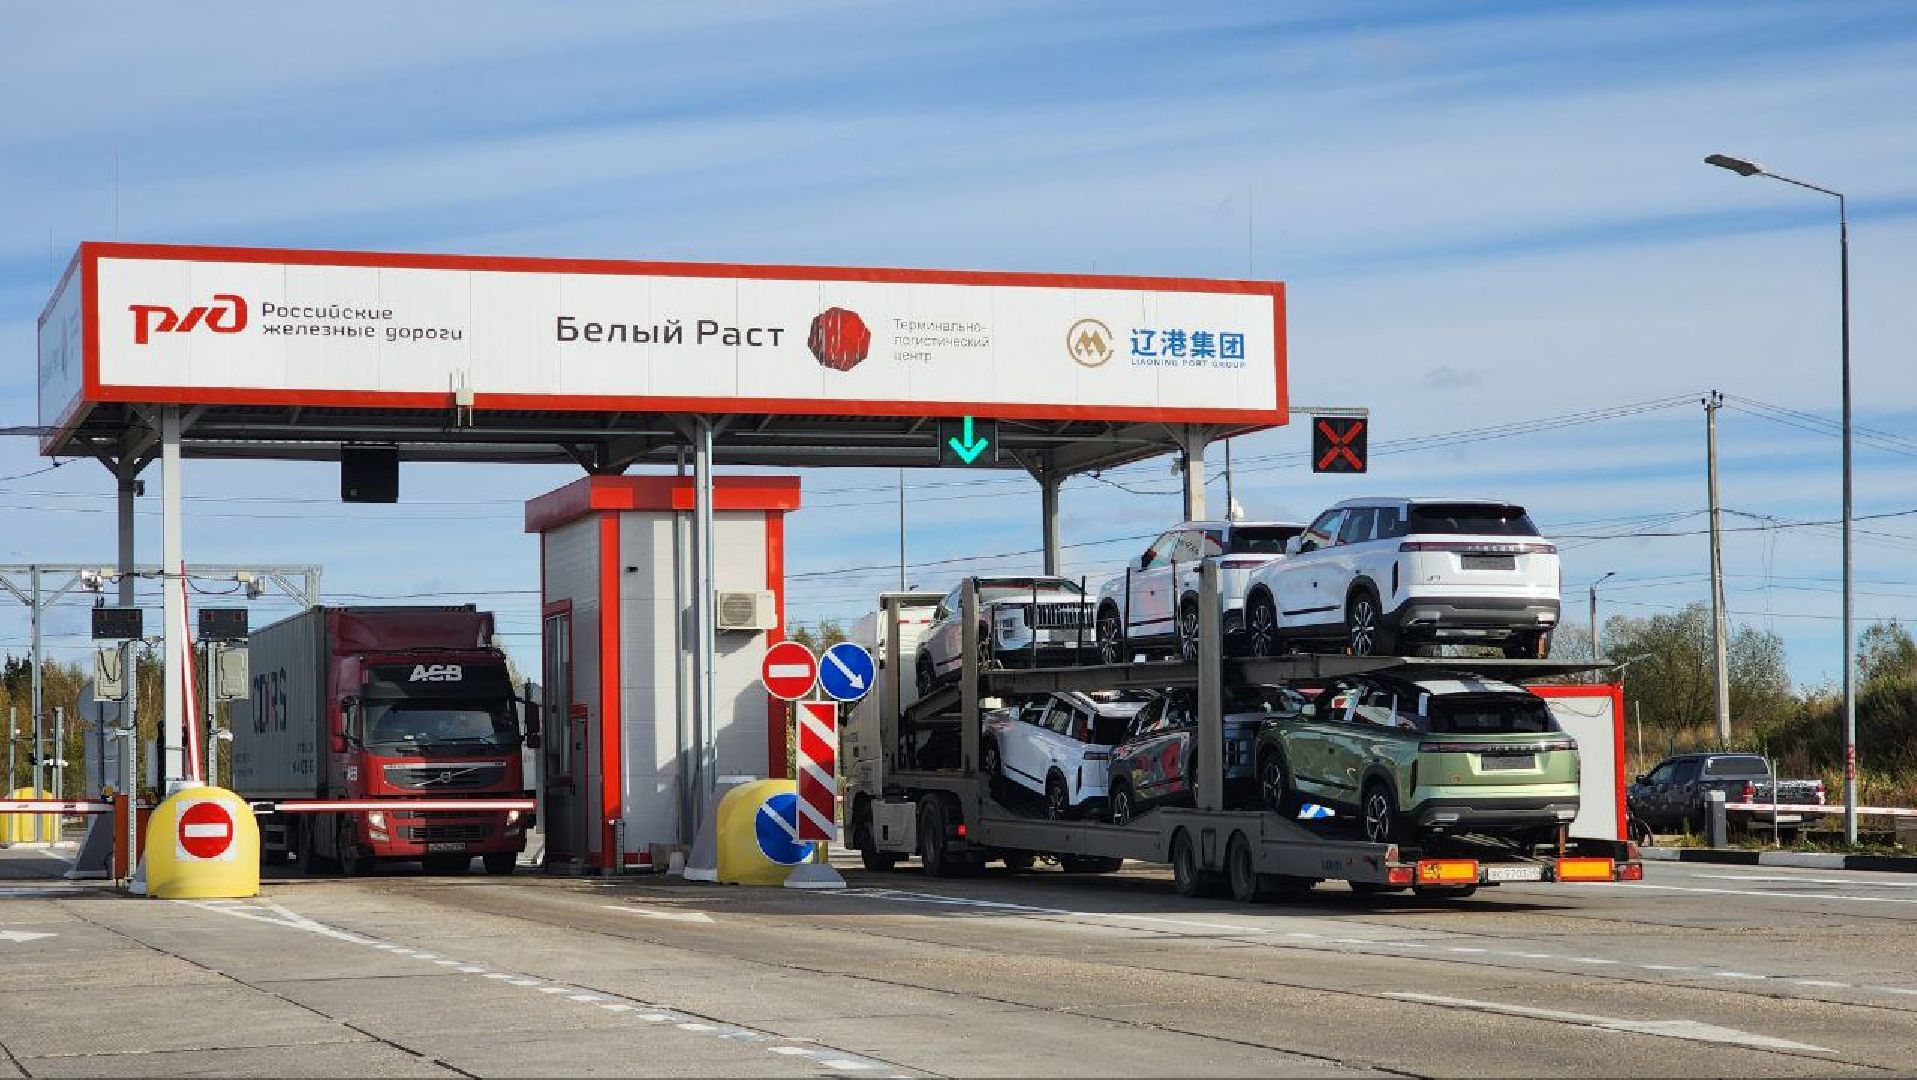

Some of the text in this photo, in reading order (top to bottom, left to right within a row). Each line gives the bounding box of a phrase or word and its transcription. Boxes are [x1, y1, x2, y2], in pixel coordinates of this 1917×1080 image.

[261, 302, 394, 320] Российские
[261, 322, 463, 342] железные дороги
[556, 316, 785, 347] Белый Раст
[892, 318, 989, 333] Терминально-
[894, 335, 990, 348] логистический
[1129, 328, 1245, 360] 辽港集团
[894, 351, 932, 363] центр
[1130, 358, 1247, 370] LIAONING PORT GROUP
